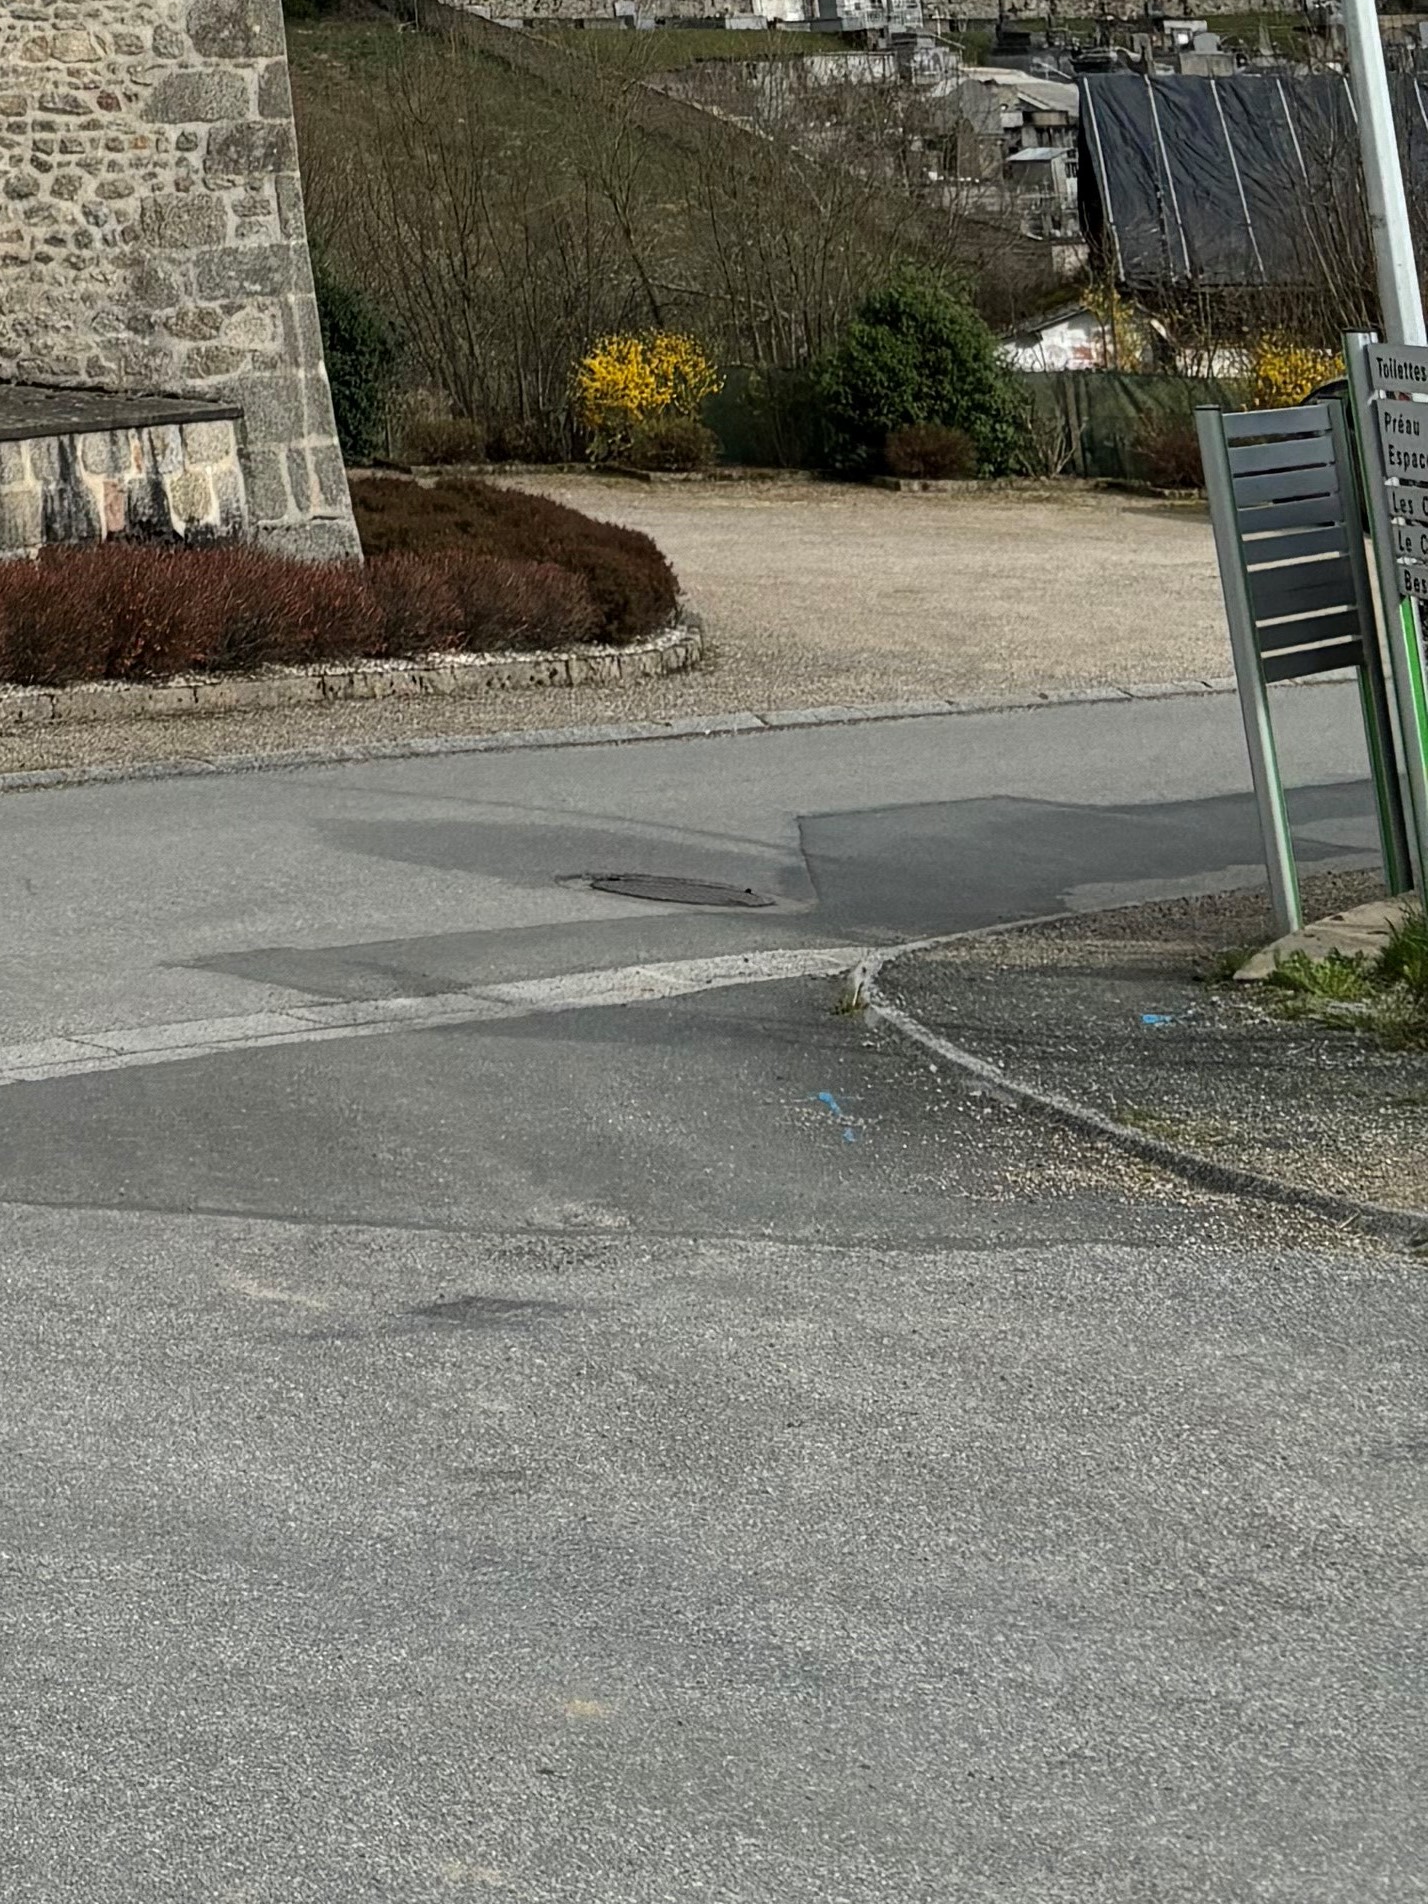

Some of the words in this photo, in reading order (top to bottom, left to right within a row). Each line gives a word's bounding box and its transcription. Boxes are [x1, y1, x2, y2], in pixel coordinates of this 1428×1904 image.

[1376, 357, 1427, 382] Toilettes
[1384, 411, 1420, 436] Préau
[1392, 491, 1414, 514] Les
[1398, 530, 1412, 552] Le
